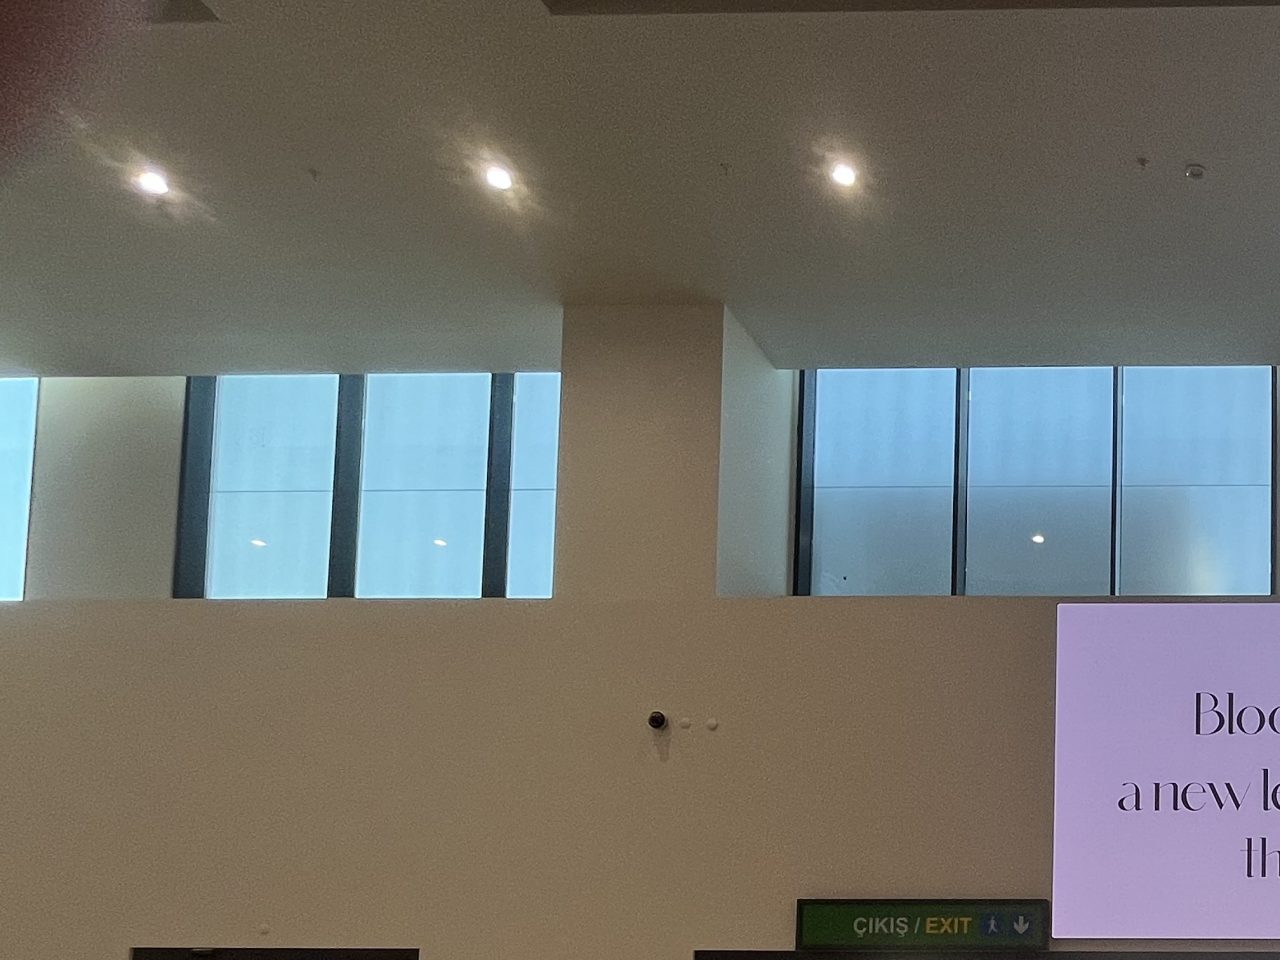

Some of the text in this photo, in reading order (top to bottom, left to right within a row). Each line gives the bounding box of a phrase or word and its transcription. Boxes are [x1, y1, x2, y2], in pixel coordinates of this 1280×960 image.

[1117, 780, 1143, 812] a
[1153, 780, 1249, 812] new
[853, 917, 909, 937] ÇIKIŞ
[925, 917, 973, 934] EXIT
